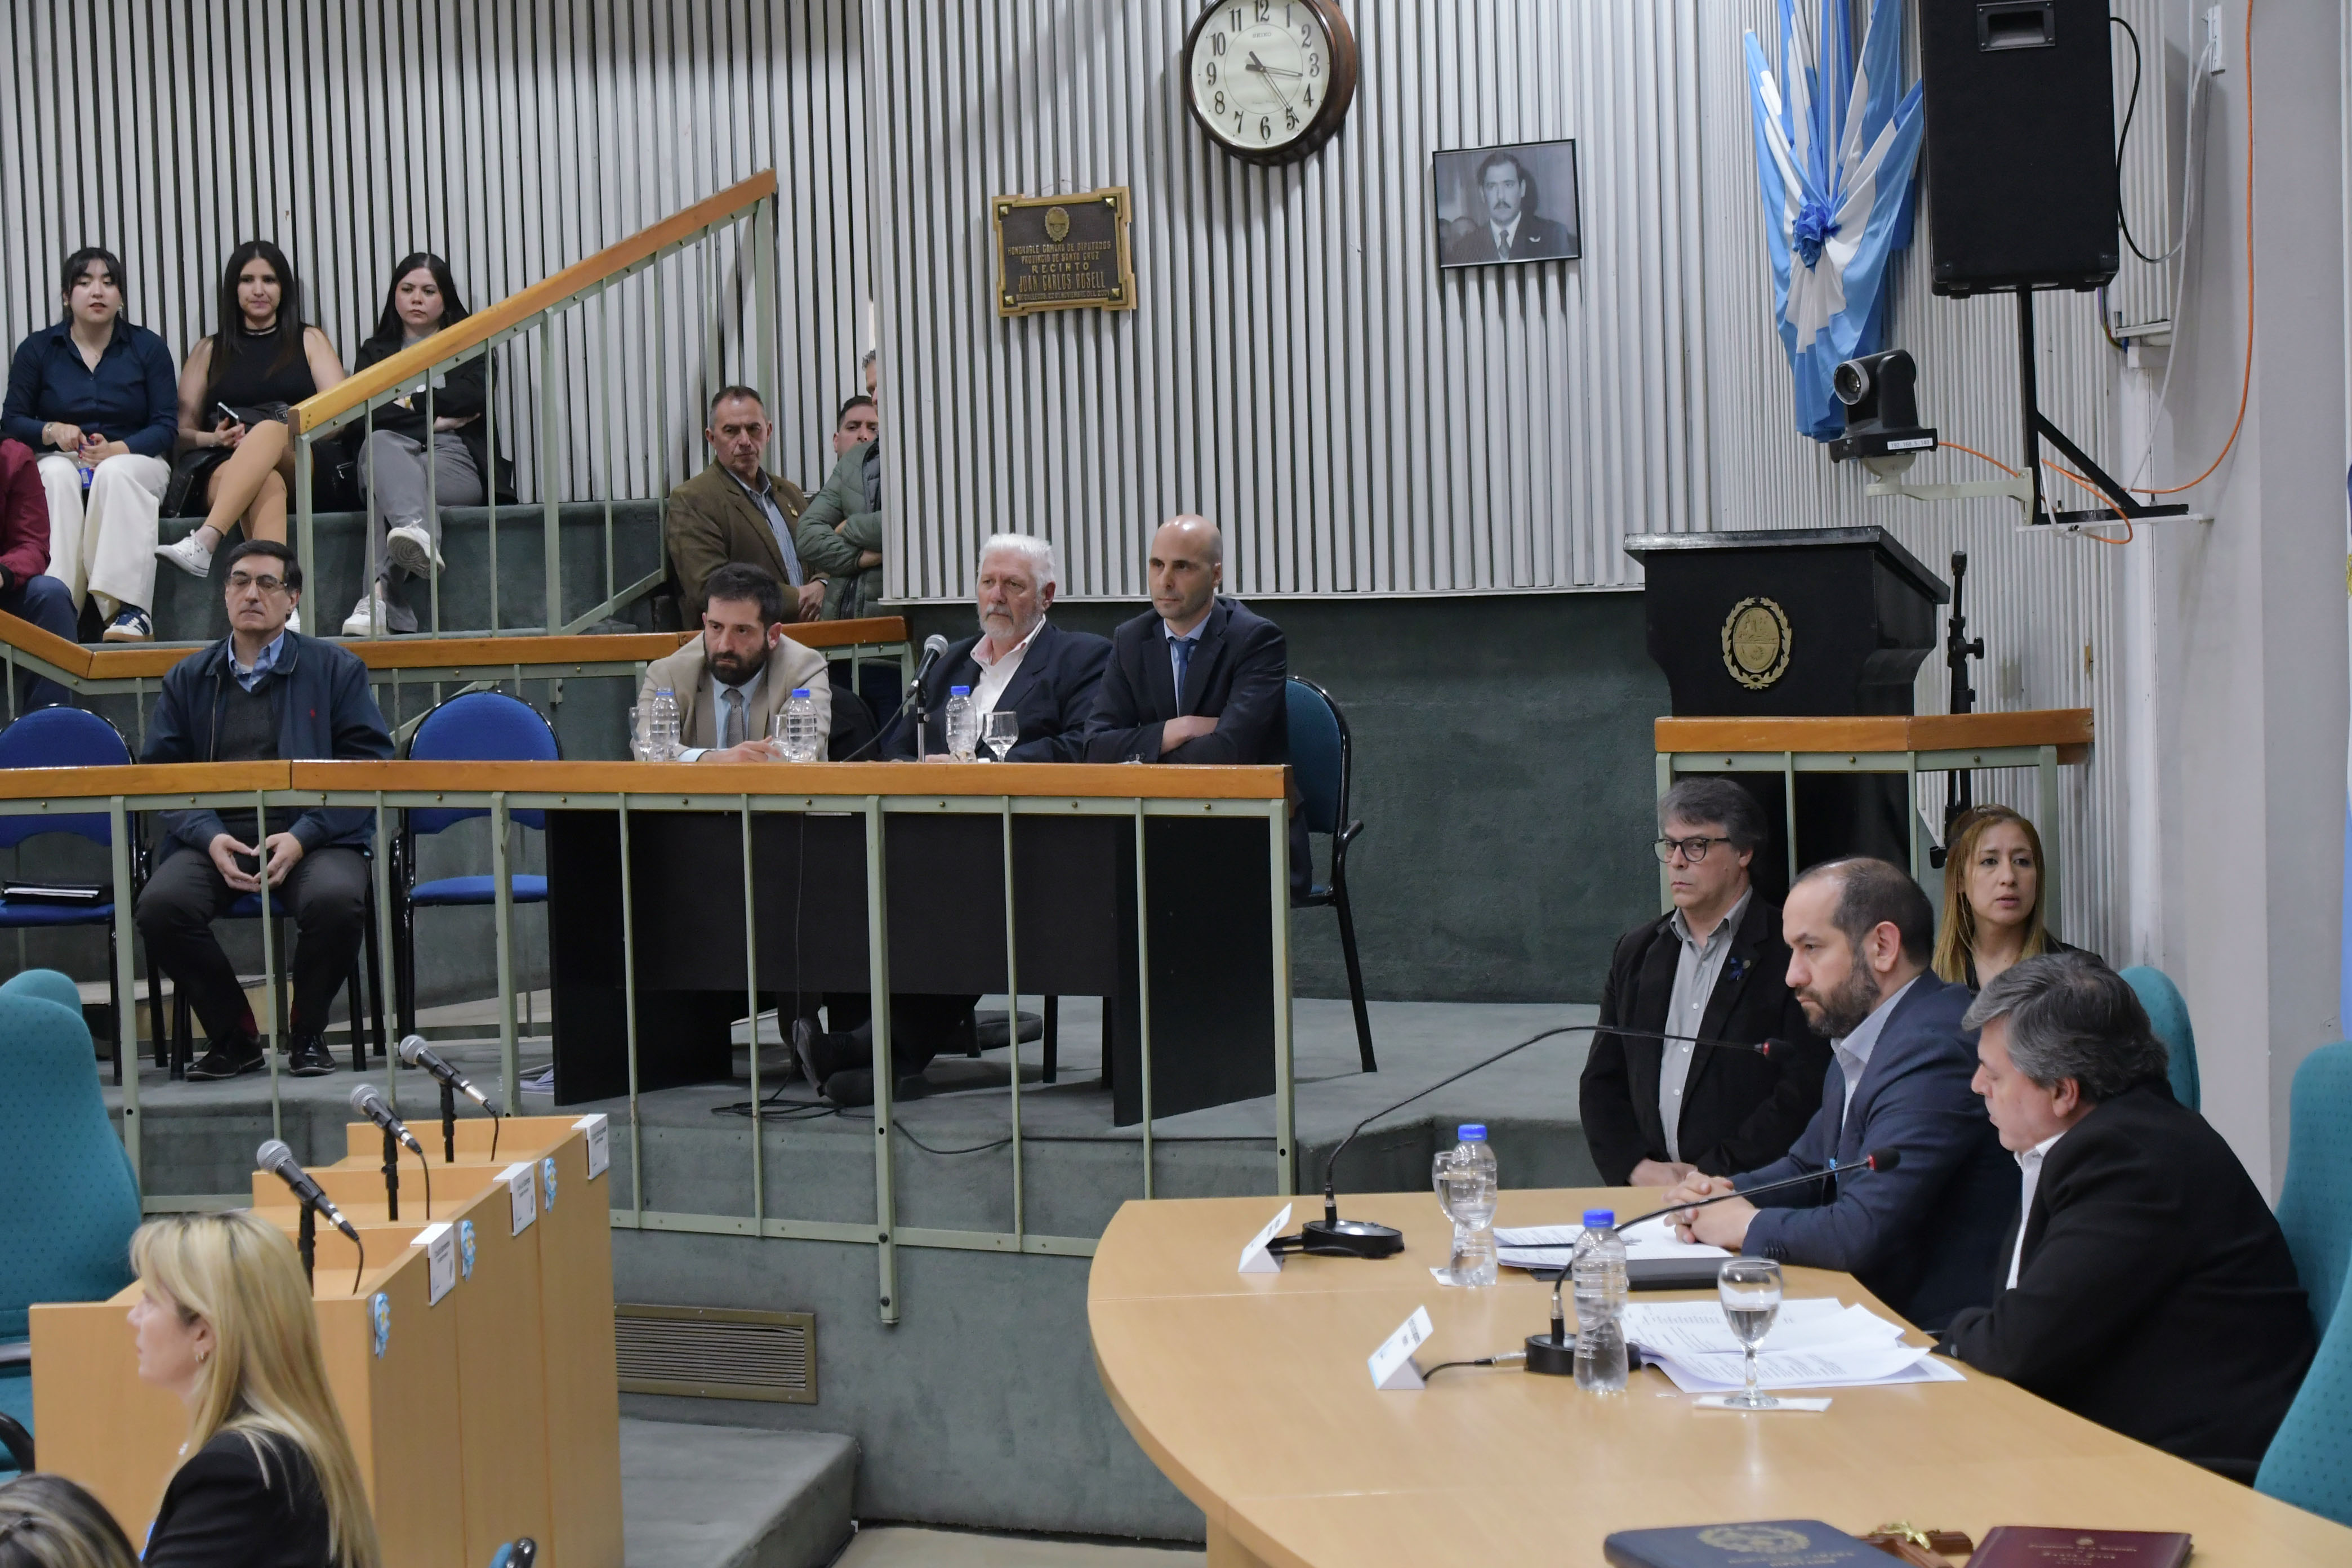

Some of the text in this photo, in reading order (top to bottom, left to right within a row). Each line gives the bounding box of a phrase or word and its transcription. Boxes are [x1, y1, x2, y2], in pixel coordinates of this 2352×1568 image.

[1229, 8, 1242, 32] 11
[1254, 0, 1269, 22] 12
[1285, 4, 1290, 28] 1
[1210, 32, 1226, 56] 10
[1300, 24, 1312, 48] 2
[1206, 62, 1217, 86] 9
[1309, 53, 1320, 77] 3
[1214, 91, 1226, 114] 8
[1303, 83, 1314, 108] 4
[1233, 110, 1244, 134] 7
[1260, 116, 1271, 140] 6
[1285, 106, 1295, 130] 5
[1008, 244, 1039, 255] HONORABLE
[1067, 243, 1074, 252] DE
[1077, 240, 1111, 251] DIPUTADOS
[1021, 251, 1099, 265] PROVINCIA DE SANTA CRUZ
[1032, 261, 1090, 274] RECINTO
[1019, 271, 1106, 292] JUAN CARLOS ROSELL
[1891, 439, 1930, 448] 192.168.5.140
